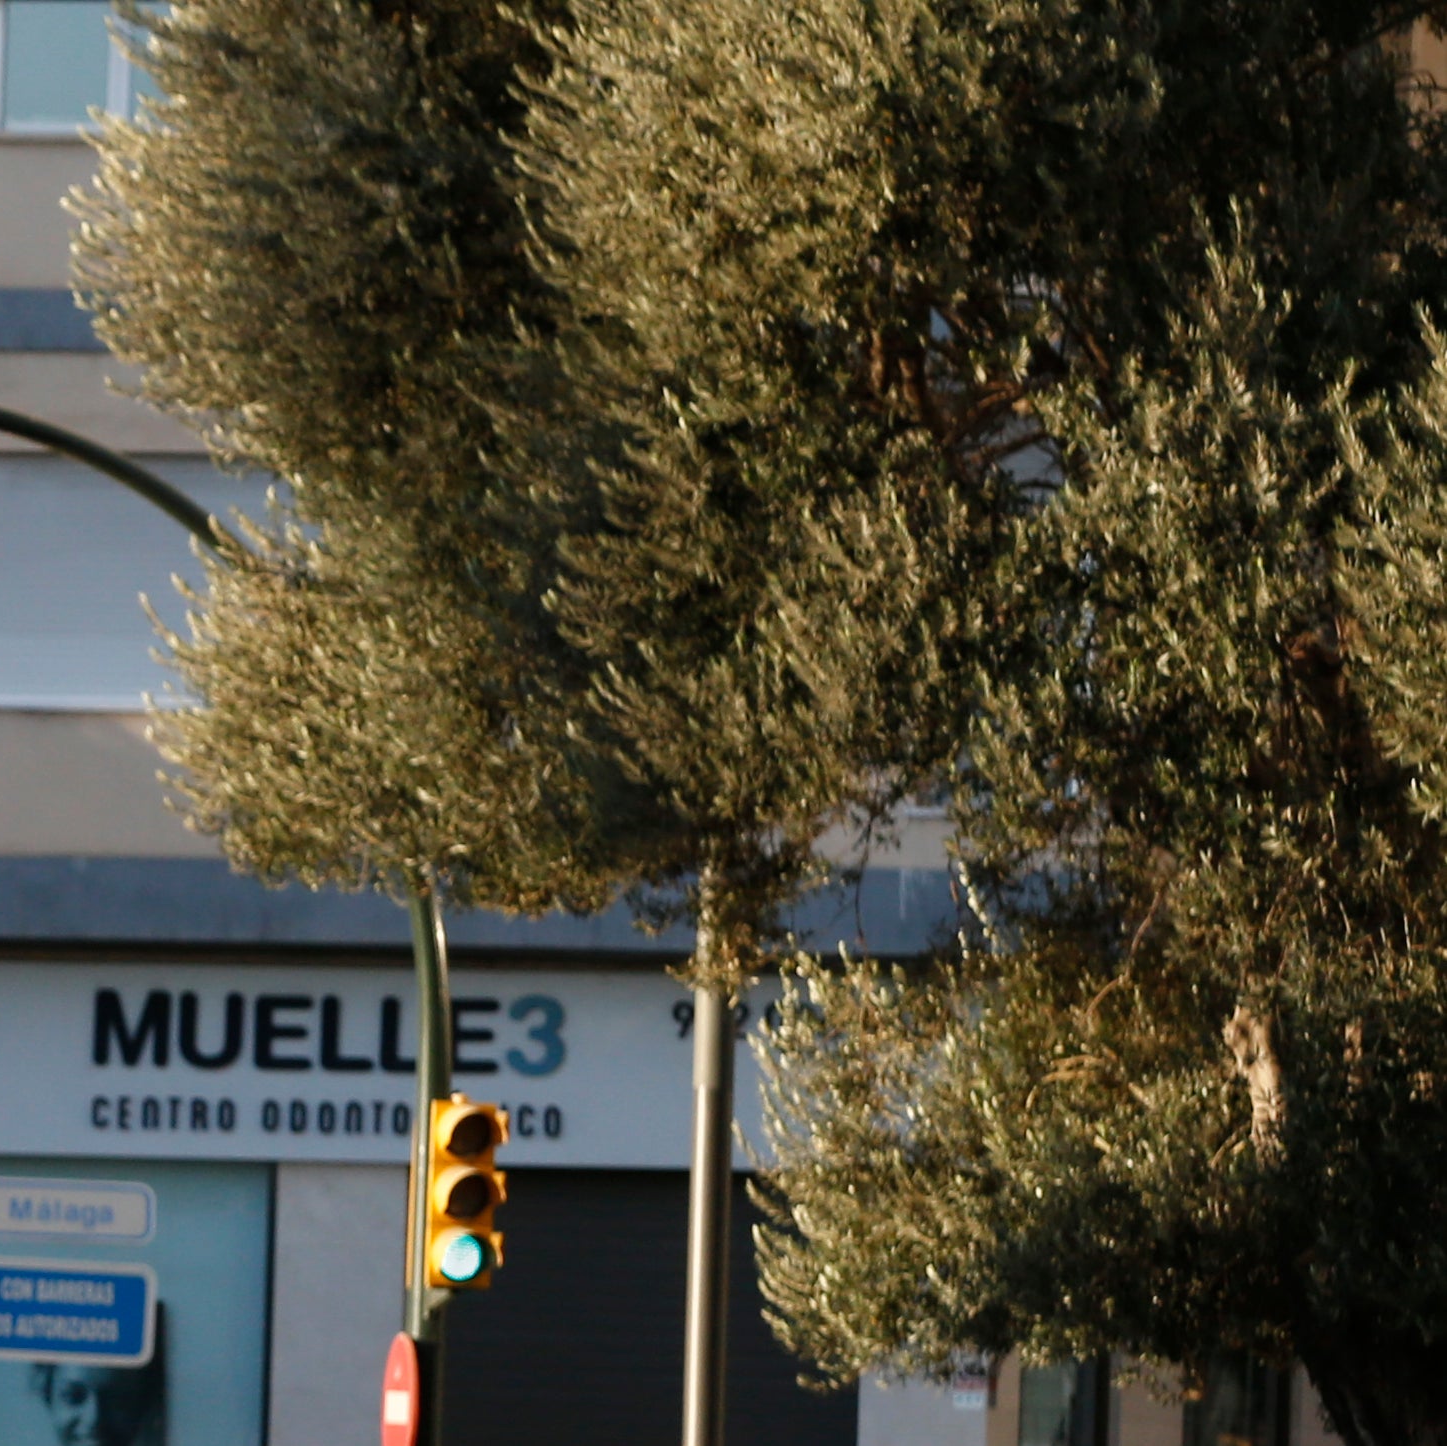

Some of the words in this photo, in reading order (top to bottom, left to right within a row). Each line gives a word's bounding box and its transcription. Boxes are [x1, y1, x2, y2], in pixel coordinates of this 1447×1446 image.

[92, 987, 567, 1078] MUELLE3
[91, 1095, 236, 1132] CENTRO
[262, 1099, 563, 1139] ODONTOCO
[9, 1196, 115, 1229] Málaga
[0, 1277, 33, 1302] CON
[38, 1279, 116, 1306] BARRERAS
[15, 1314, 120, 1343] AUTORIZADOS
